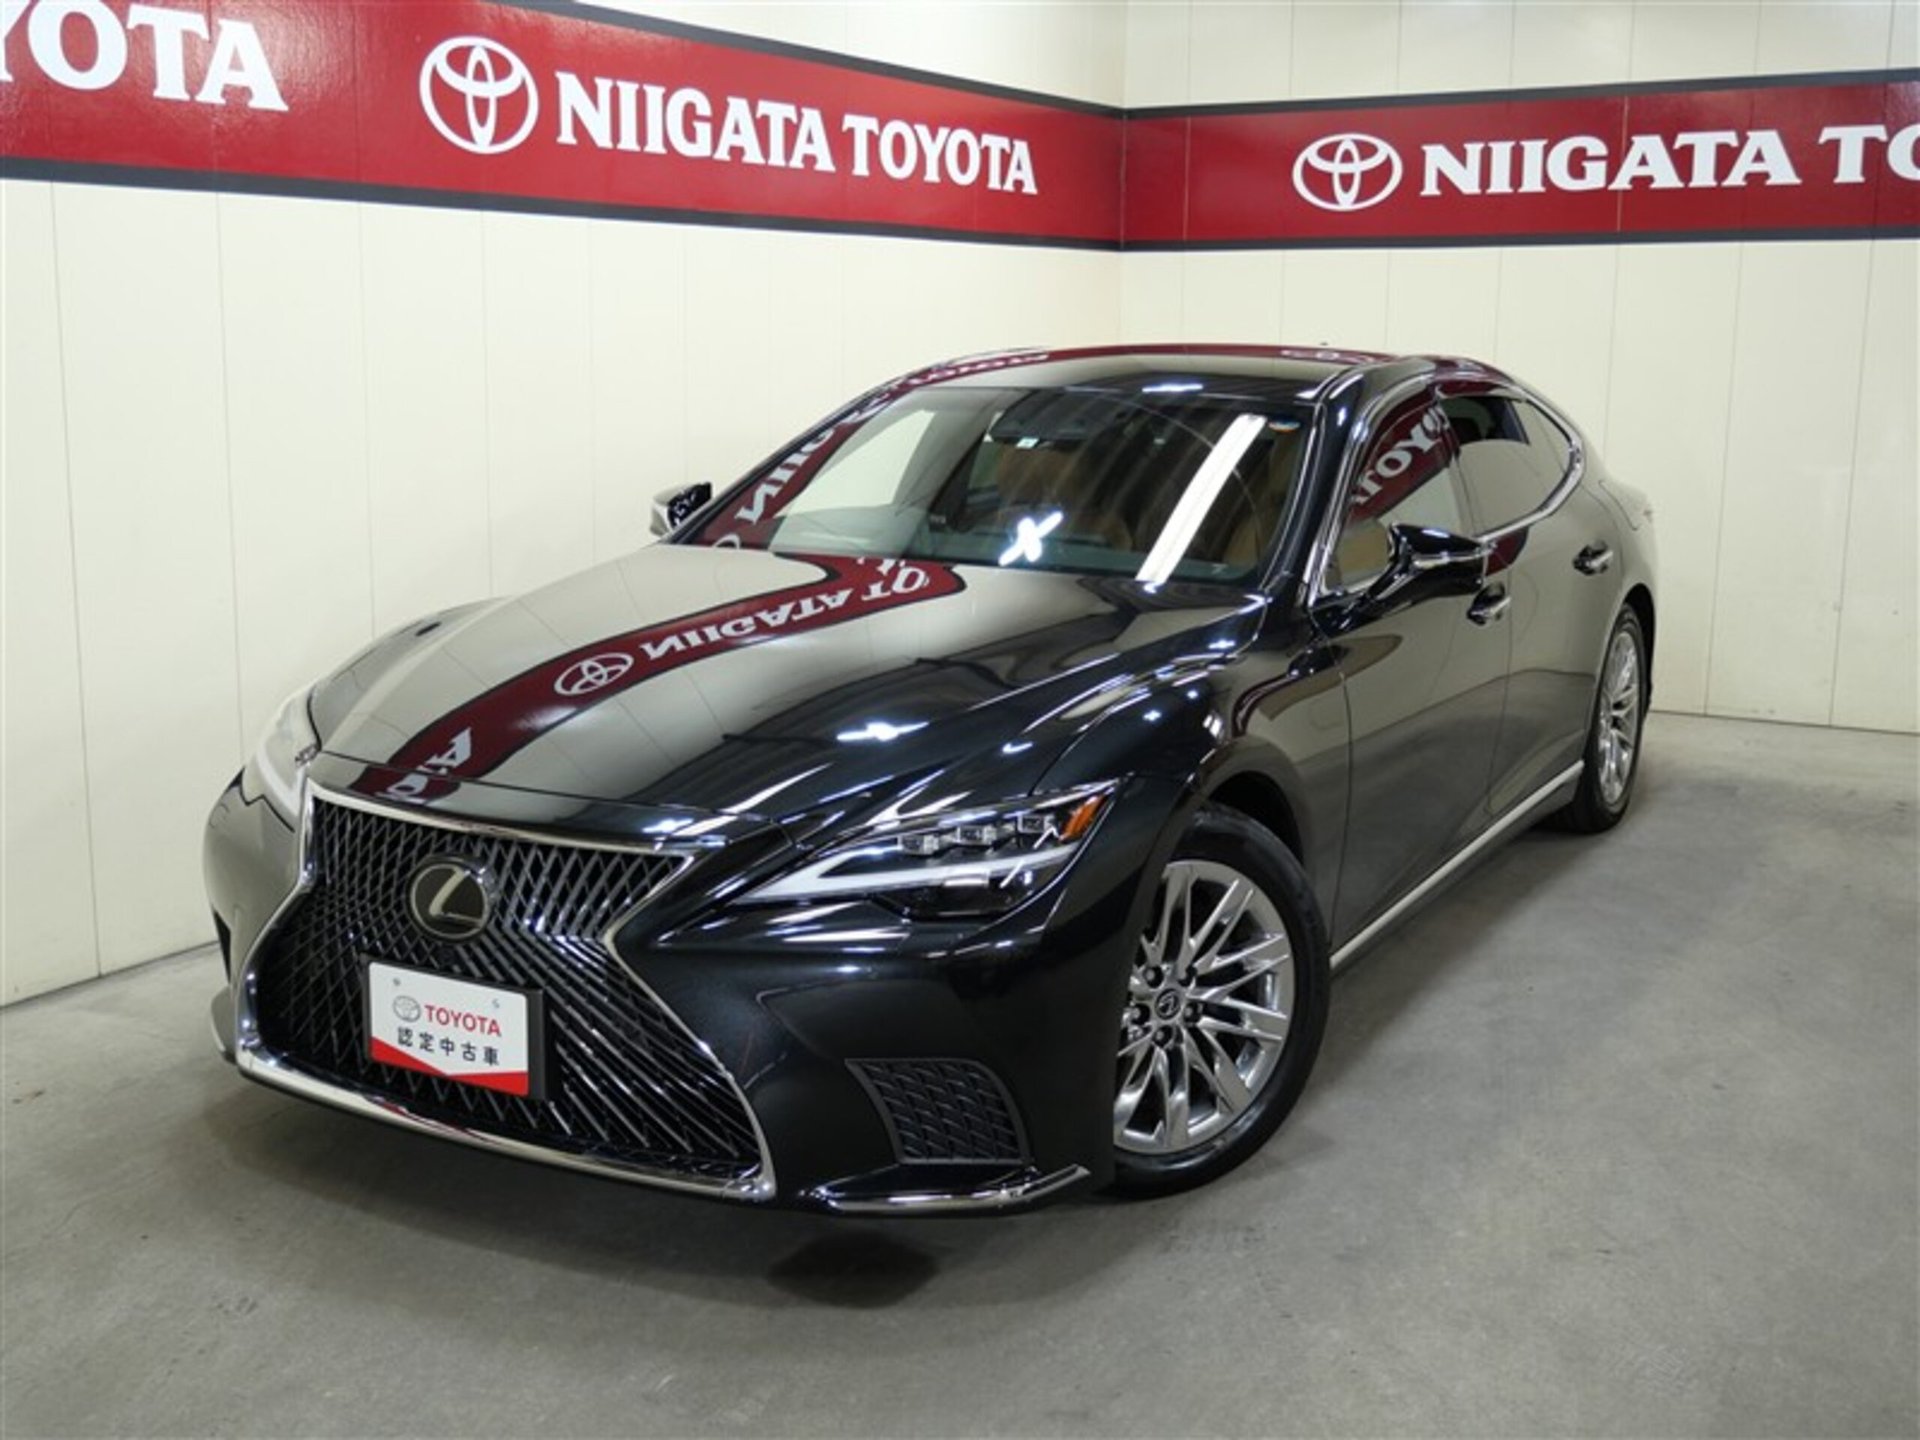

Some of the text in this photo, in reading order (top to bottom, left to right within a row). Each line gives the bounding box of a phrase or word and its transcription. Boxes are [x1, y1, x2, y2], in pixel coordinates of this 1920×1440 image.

[555, 70, 1039, 196] NIIGATA TOYOTA
[1419, 130, 1803, 196] NIIGATA
[397, 1026, 500, 1066] 認定中古車
[424, 1004, 502, 1038] TOYOTA
